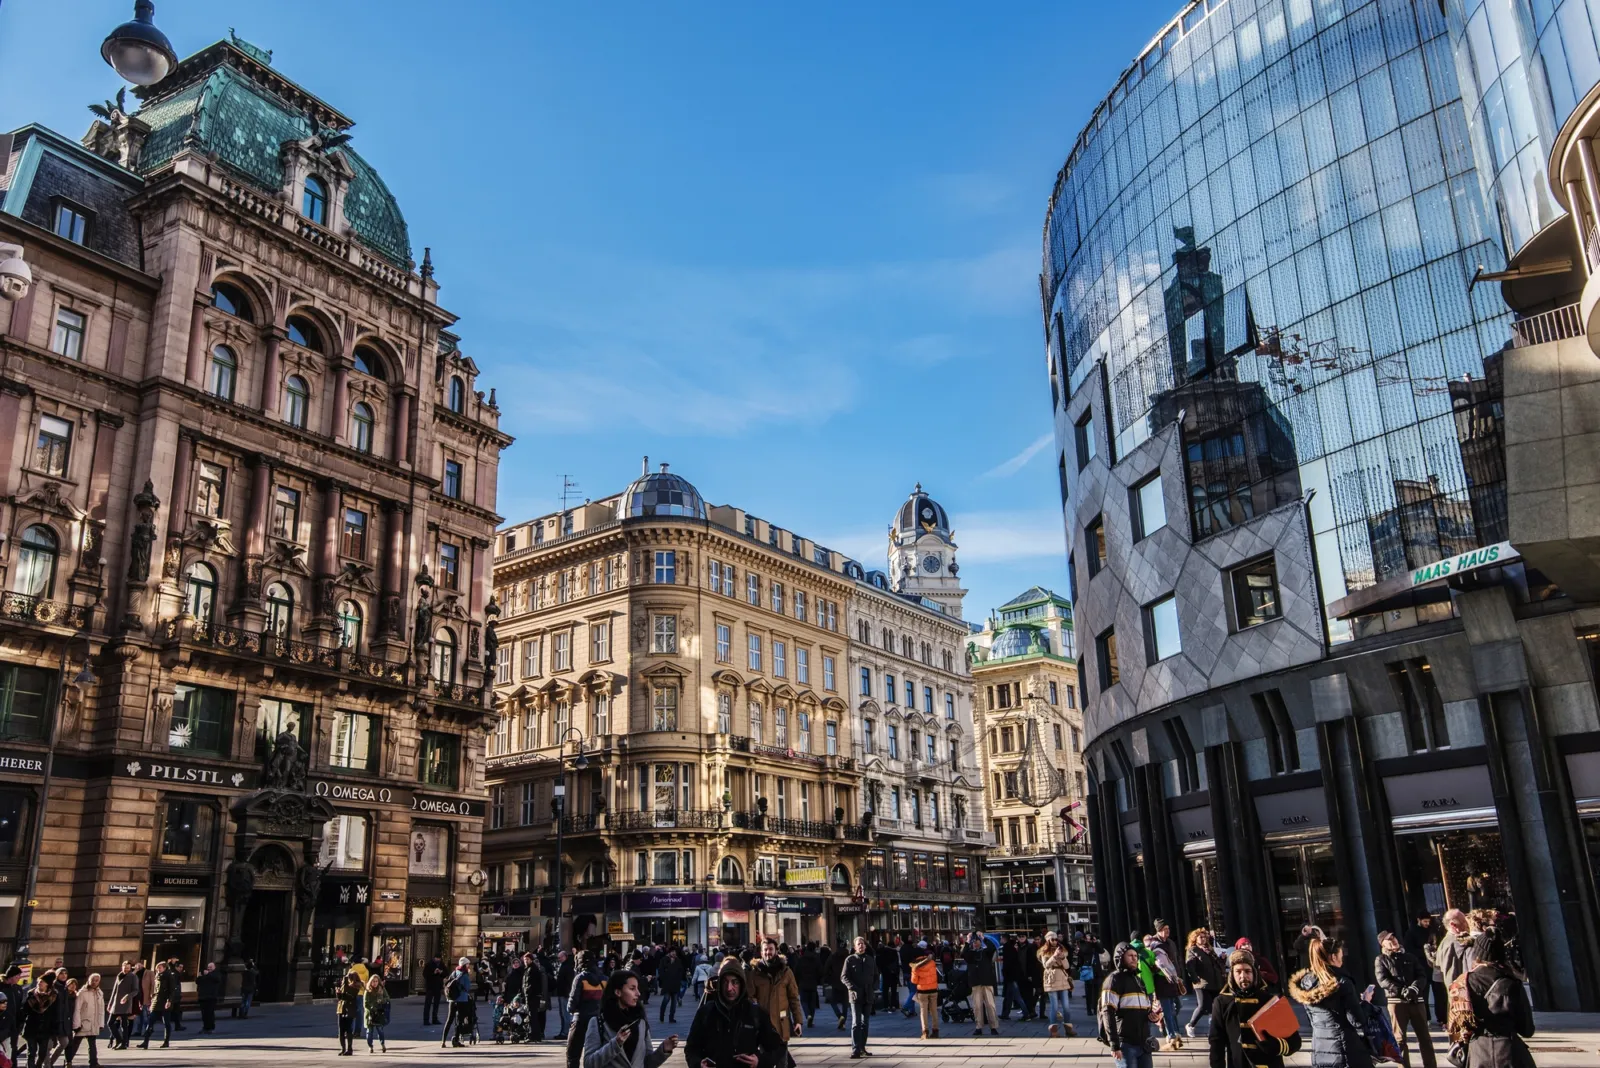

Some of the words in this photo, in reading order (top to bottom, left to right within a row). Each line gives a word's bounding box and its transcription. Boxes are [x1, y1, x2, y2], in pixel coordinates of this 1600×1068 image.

[1414, 560, 1451, 585] HAAS
[1457, 545, 1499, 571] HAUS
[149, 764, 224, 784] PILSTL
[332, 785, 376, 801] OMEGA
[419, 799, 457, 814] OMEGA
[1421, 796, 1460, 809] ZARA
[1281, 815, 1310, 826] ZARA
[1188, 829, 1208, 839] ZARA
[164, 877, 199, 885] BUCHERER
